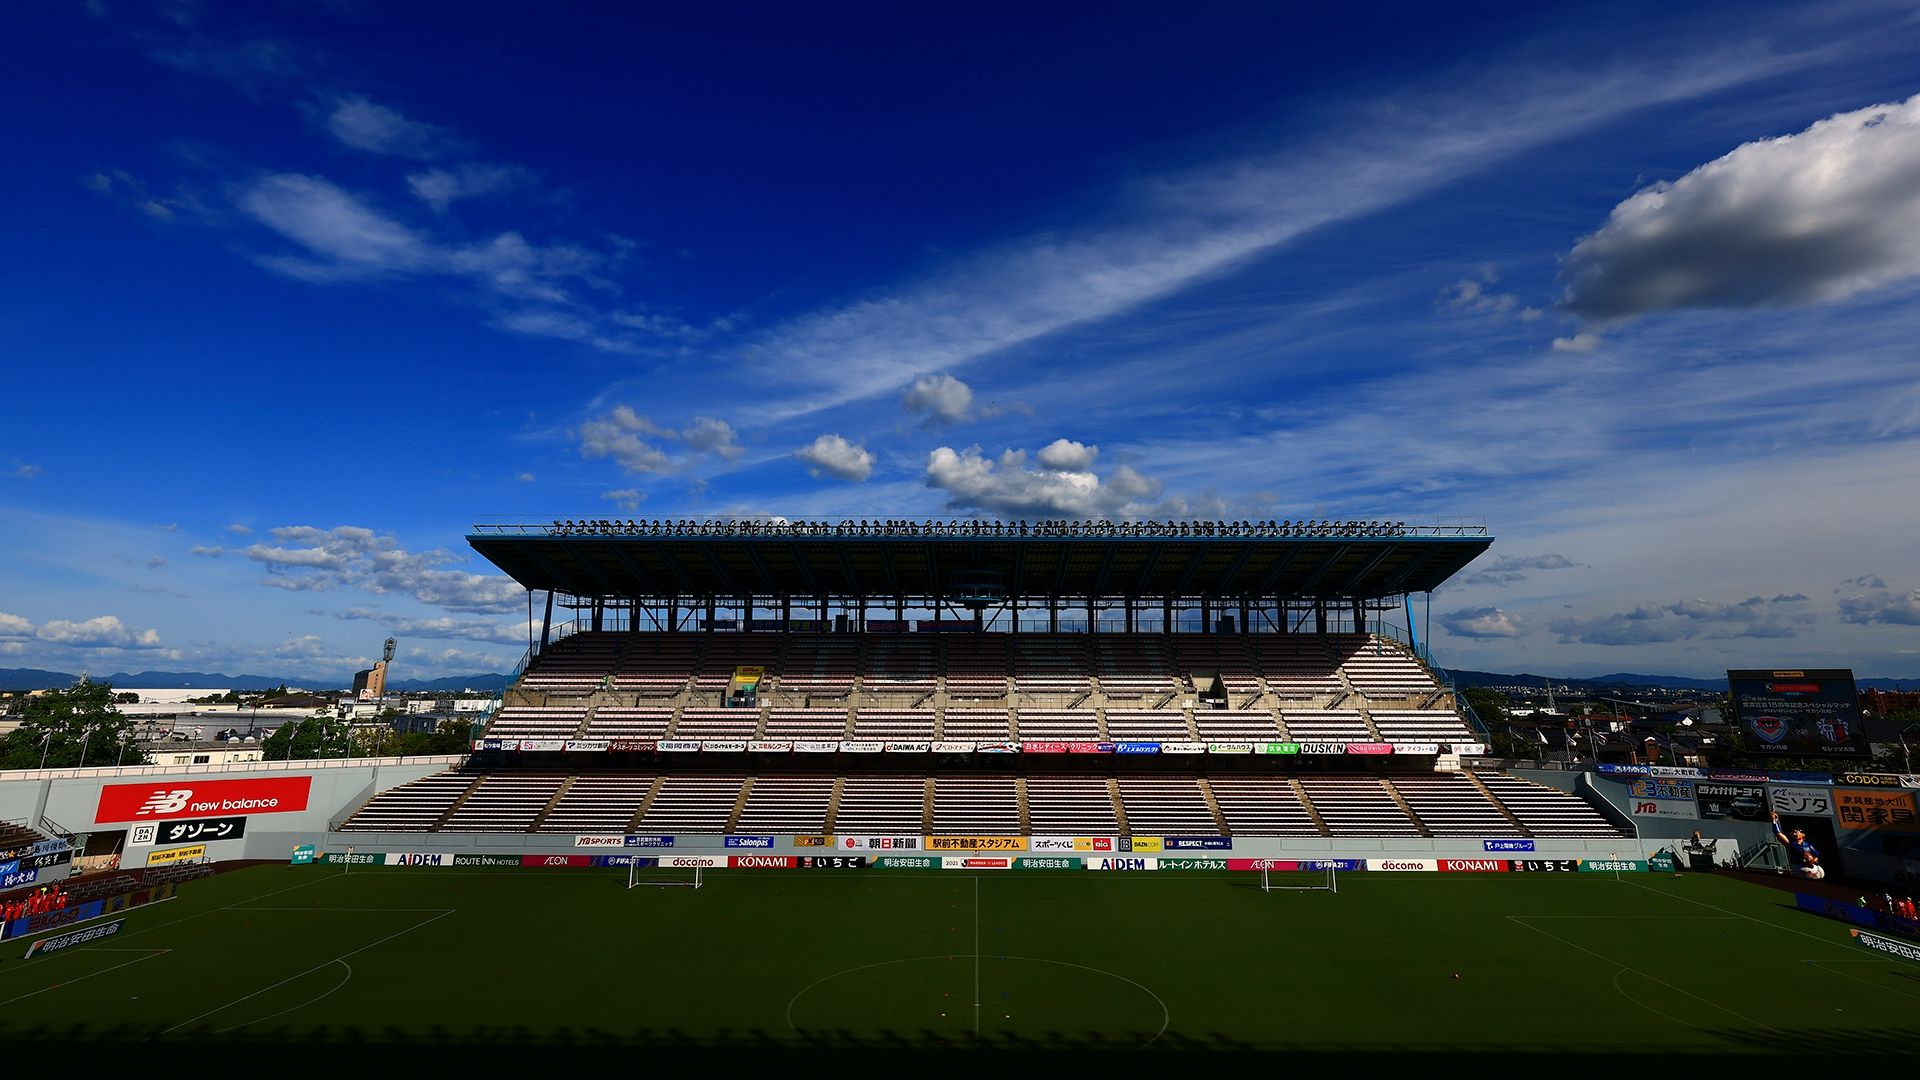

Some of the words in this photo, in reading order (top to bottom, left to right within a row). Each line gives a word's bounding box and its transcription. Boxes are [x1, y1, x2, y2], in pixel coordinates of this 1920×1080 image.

[1303, 743, 1344, 754] DUSKIN
[1846, 774, 1880, 785] CODO
[1698, 785, 1763, 797] 西九州トヨタ
[190, 801, 219, 812] new
[222, 797, 279, 811] balance
[1635, 802, 1657, 814] JTB
[1774, 796, 1828, 813] ミゾタ
[1840, 806, 1916, 825] 関家具
[169, 822, 234, 840] ダゾーン
[591, 837, 622, 845] SPORTS
[739, 838, 769, 847] Salonpas
[868, 838, 917, 849] 朝日新聞
[932, 838, 1020, 849] 駅前不動産スタジアム
[1035, 839, 1073, 849] スポーツくじ
[328, 854, 375, 864] 明治安田生命
[455, 857, 480, 865] ROUTE
[672, 857, 714, 867] docomo
[737, 857, 787, 867] KONAMI
[817, 857, 858, 868] いちご
[883, 858, 931, 868] 明治安田生命
[1022, 859, 1070, 868] 明治安田生命
[1381, 860, 1424, 871] docomo
[1447, 861, 1498, 871] KONAMI
[1528, 861, 1570, 871] いちご
[1589, 861, 1637, 871] 明治安田生命
[43, 923, 120, 952] 明治安田生命
